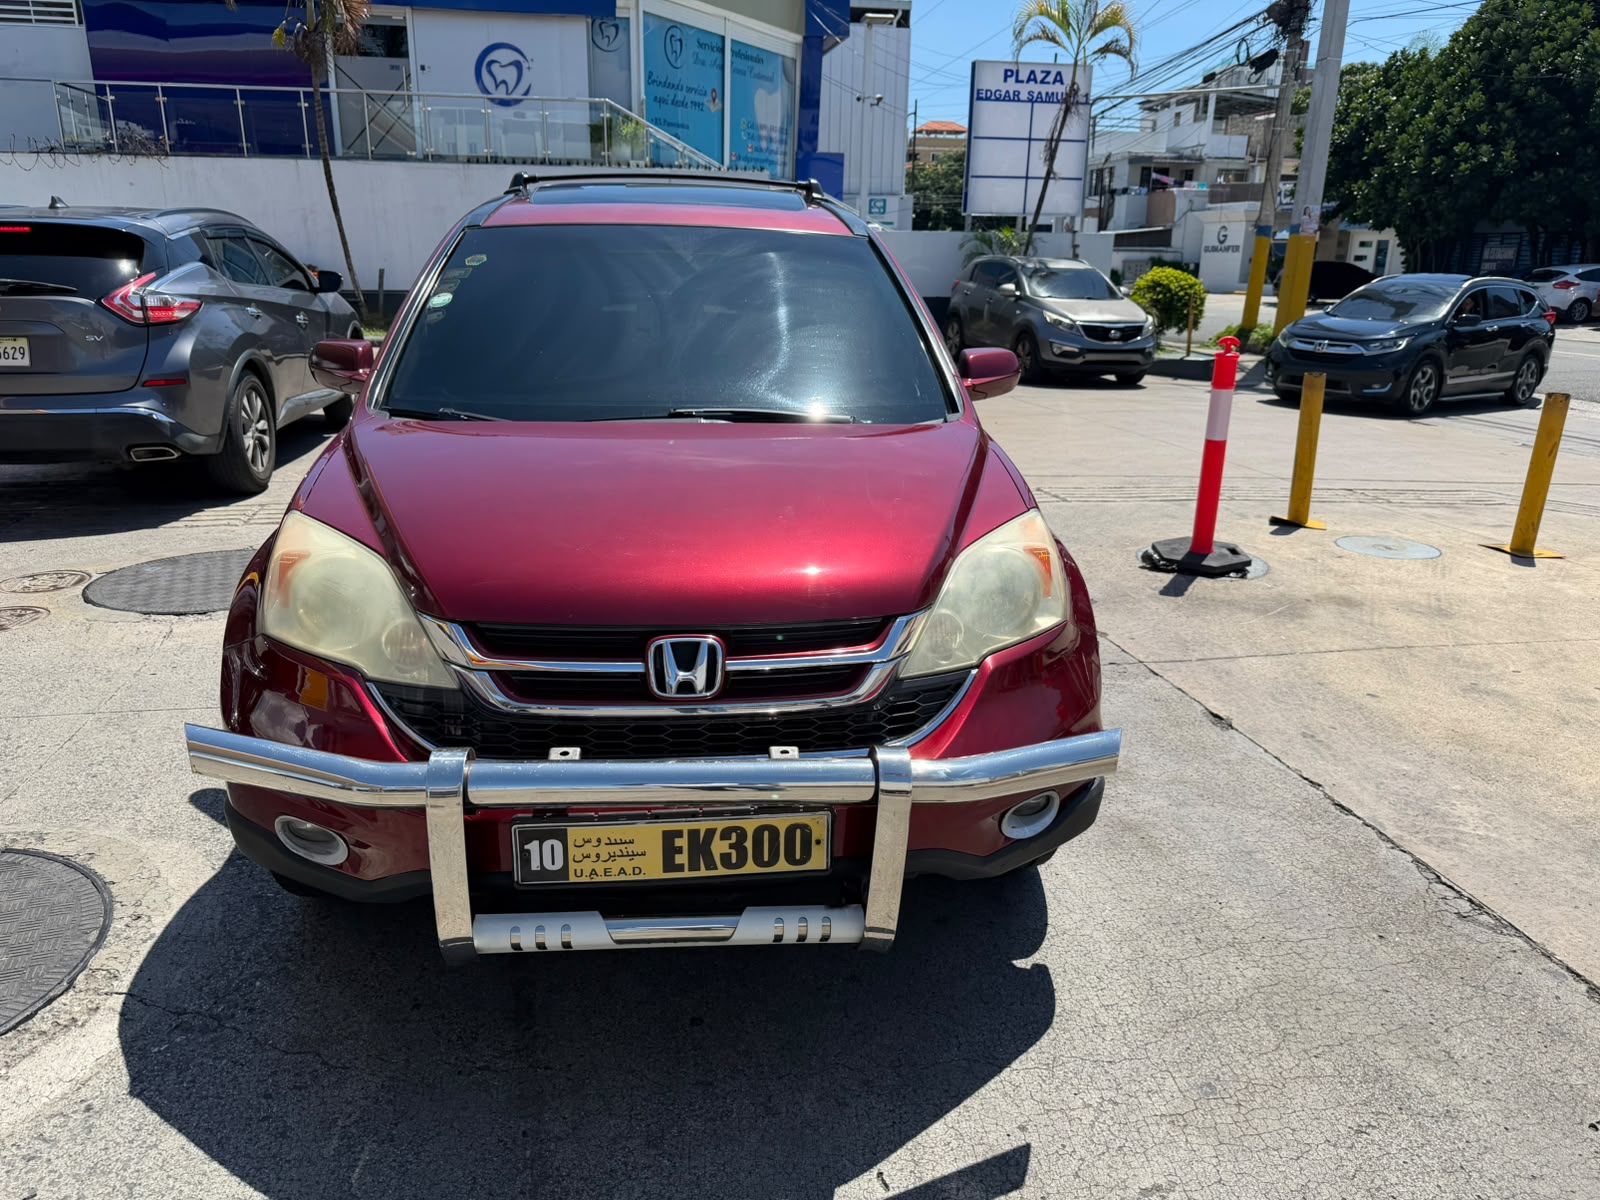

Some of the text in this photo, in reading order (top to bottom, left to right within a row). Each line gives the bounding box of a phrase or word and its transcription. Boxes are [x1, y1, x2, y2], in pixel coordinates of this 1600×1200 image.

[1003, 69, 1064, 85] PLAZA
[976, 89, 1021, 101] EDGAR
[0, 346, 25, 360] 629
[524, 839, 564, 871] 10
[662, 823, 812, 873] EK300
[574, 866, 647, 879] U.A.E.A.D.
